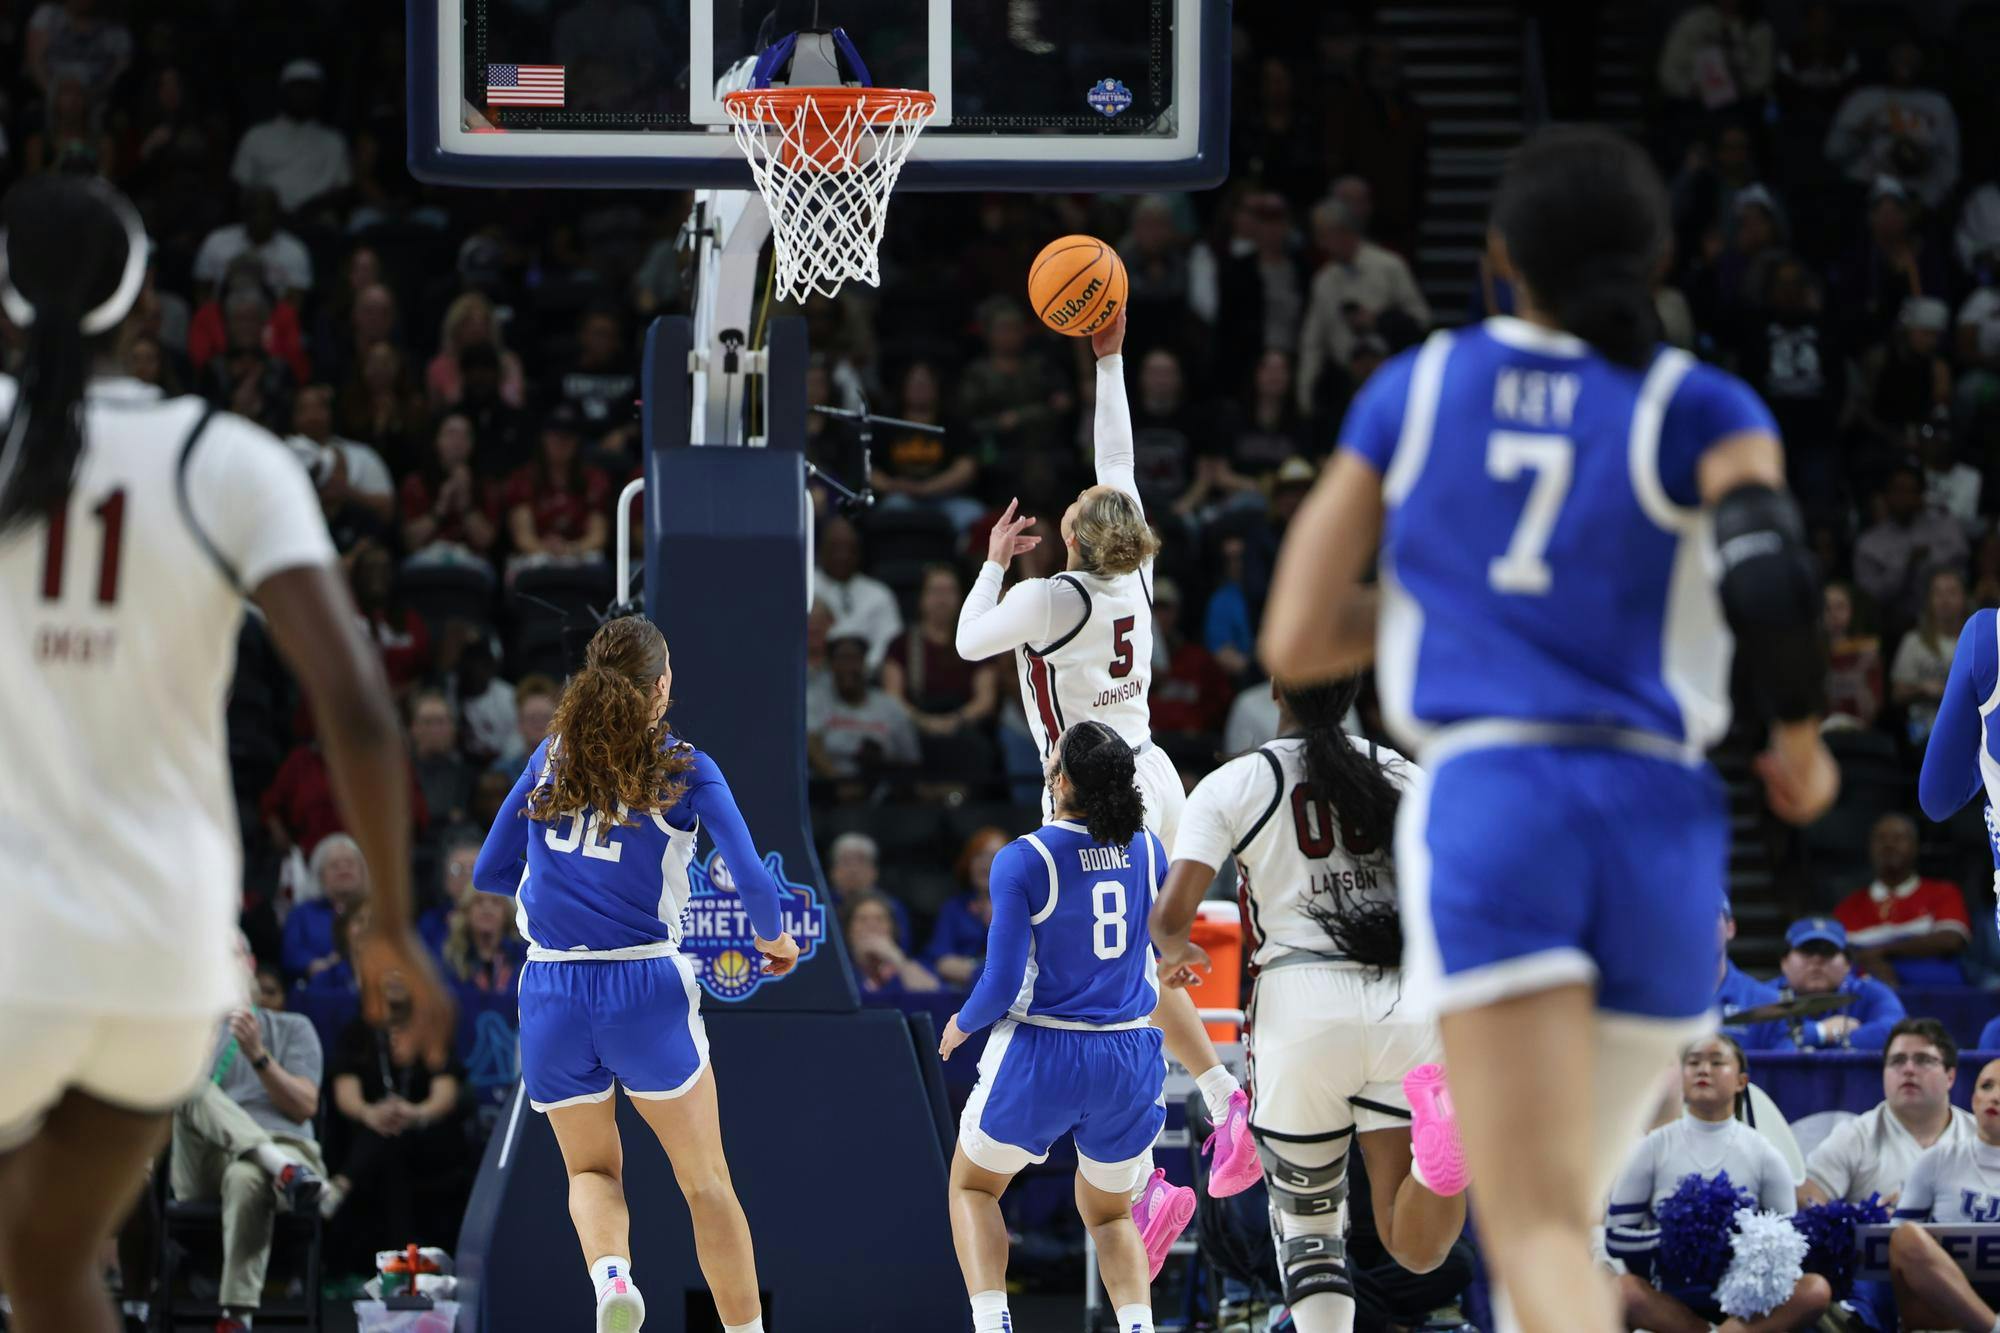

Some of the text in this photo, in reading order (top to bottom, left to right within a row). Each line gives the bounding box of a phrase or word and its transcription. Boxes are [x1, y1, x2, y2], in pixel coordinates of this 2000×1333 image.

[1049, 278, 1103, 327] Wilson
[1080, 300, 1117, 335] NCAA
[1486, 429, 1575, 596] 7
[41, 484, 127, 607] 11
[1108, 614, 1135, 679] 5
[1093, 679, 1143, 708] JOHNSON
[1078, 845, 1131, 872] BOONE
[1311, 868, 1378, 894] LATSON
[690, 899, 743, 910] WOME
[1092, 880, 1127, 960] 8
